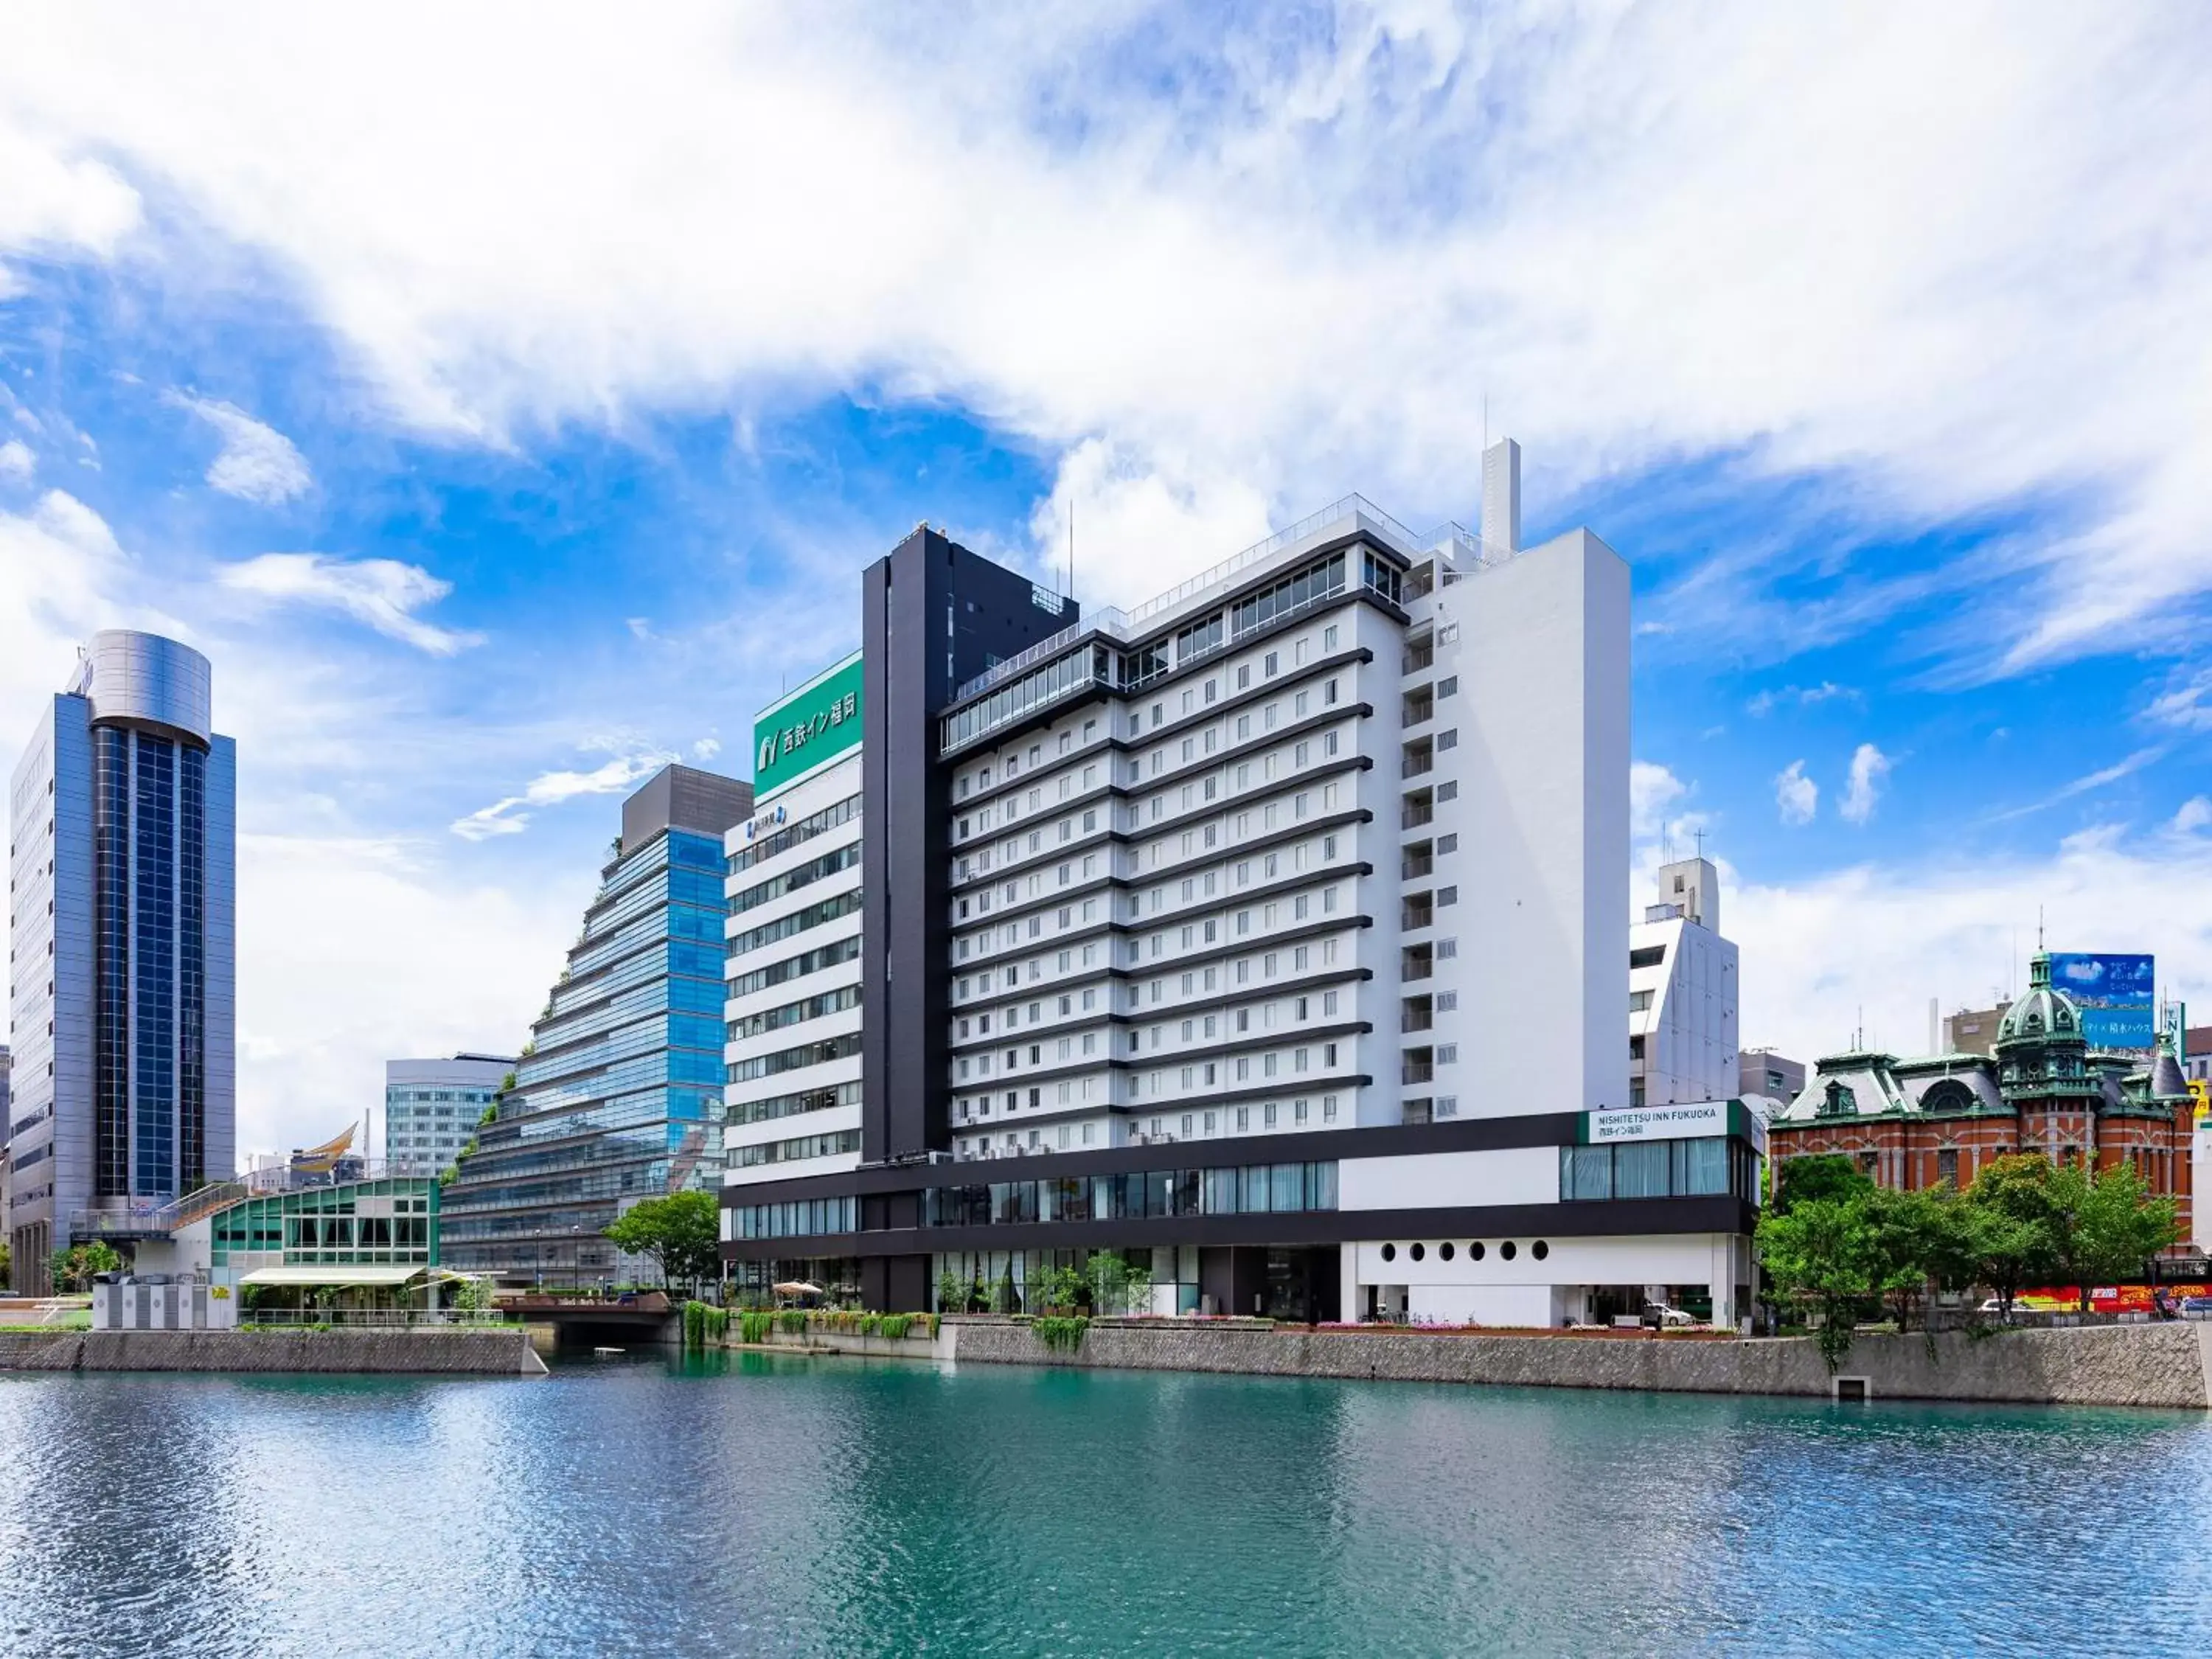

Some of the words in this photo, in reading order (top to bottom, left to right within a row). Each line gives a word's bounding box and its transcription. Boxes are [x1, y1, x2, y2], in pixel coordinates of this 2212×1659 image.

[783, 691, 856, 754] 西鉄イン福岡
[1599, 1113, 1651, 1125] NISHITETSU
[1652, 1112, 1669, 1121] INN
[1672, 1108, 1717, 1120] FUKUOKA
